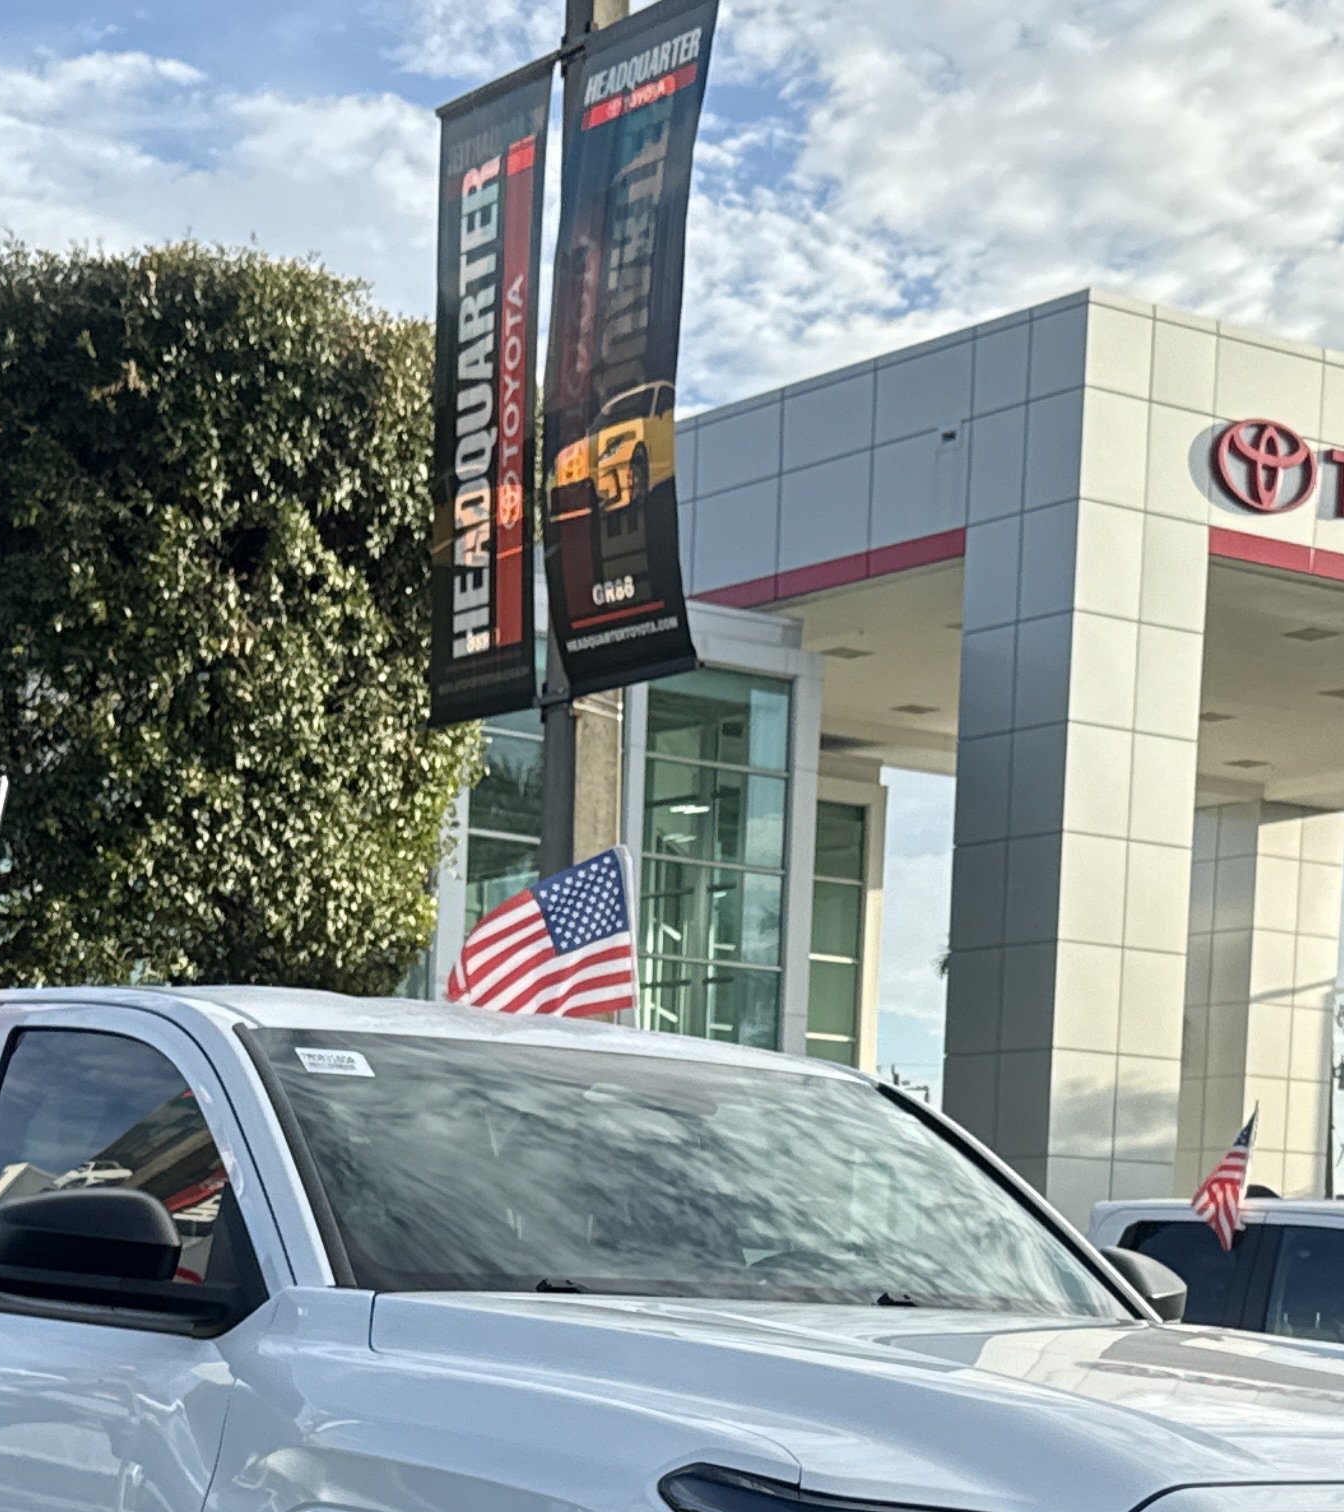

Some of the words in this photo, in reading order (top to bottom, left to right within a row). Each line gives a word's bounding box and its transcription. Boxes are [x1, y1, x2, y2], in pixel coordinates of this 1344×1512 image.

[584, 27, 702, 107] HEADQUARTER
[452, 155, 502, 659] HEADQUARTER
[501, 274, 524, 465] TOYOTA
